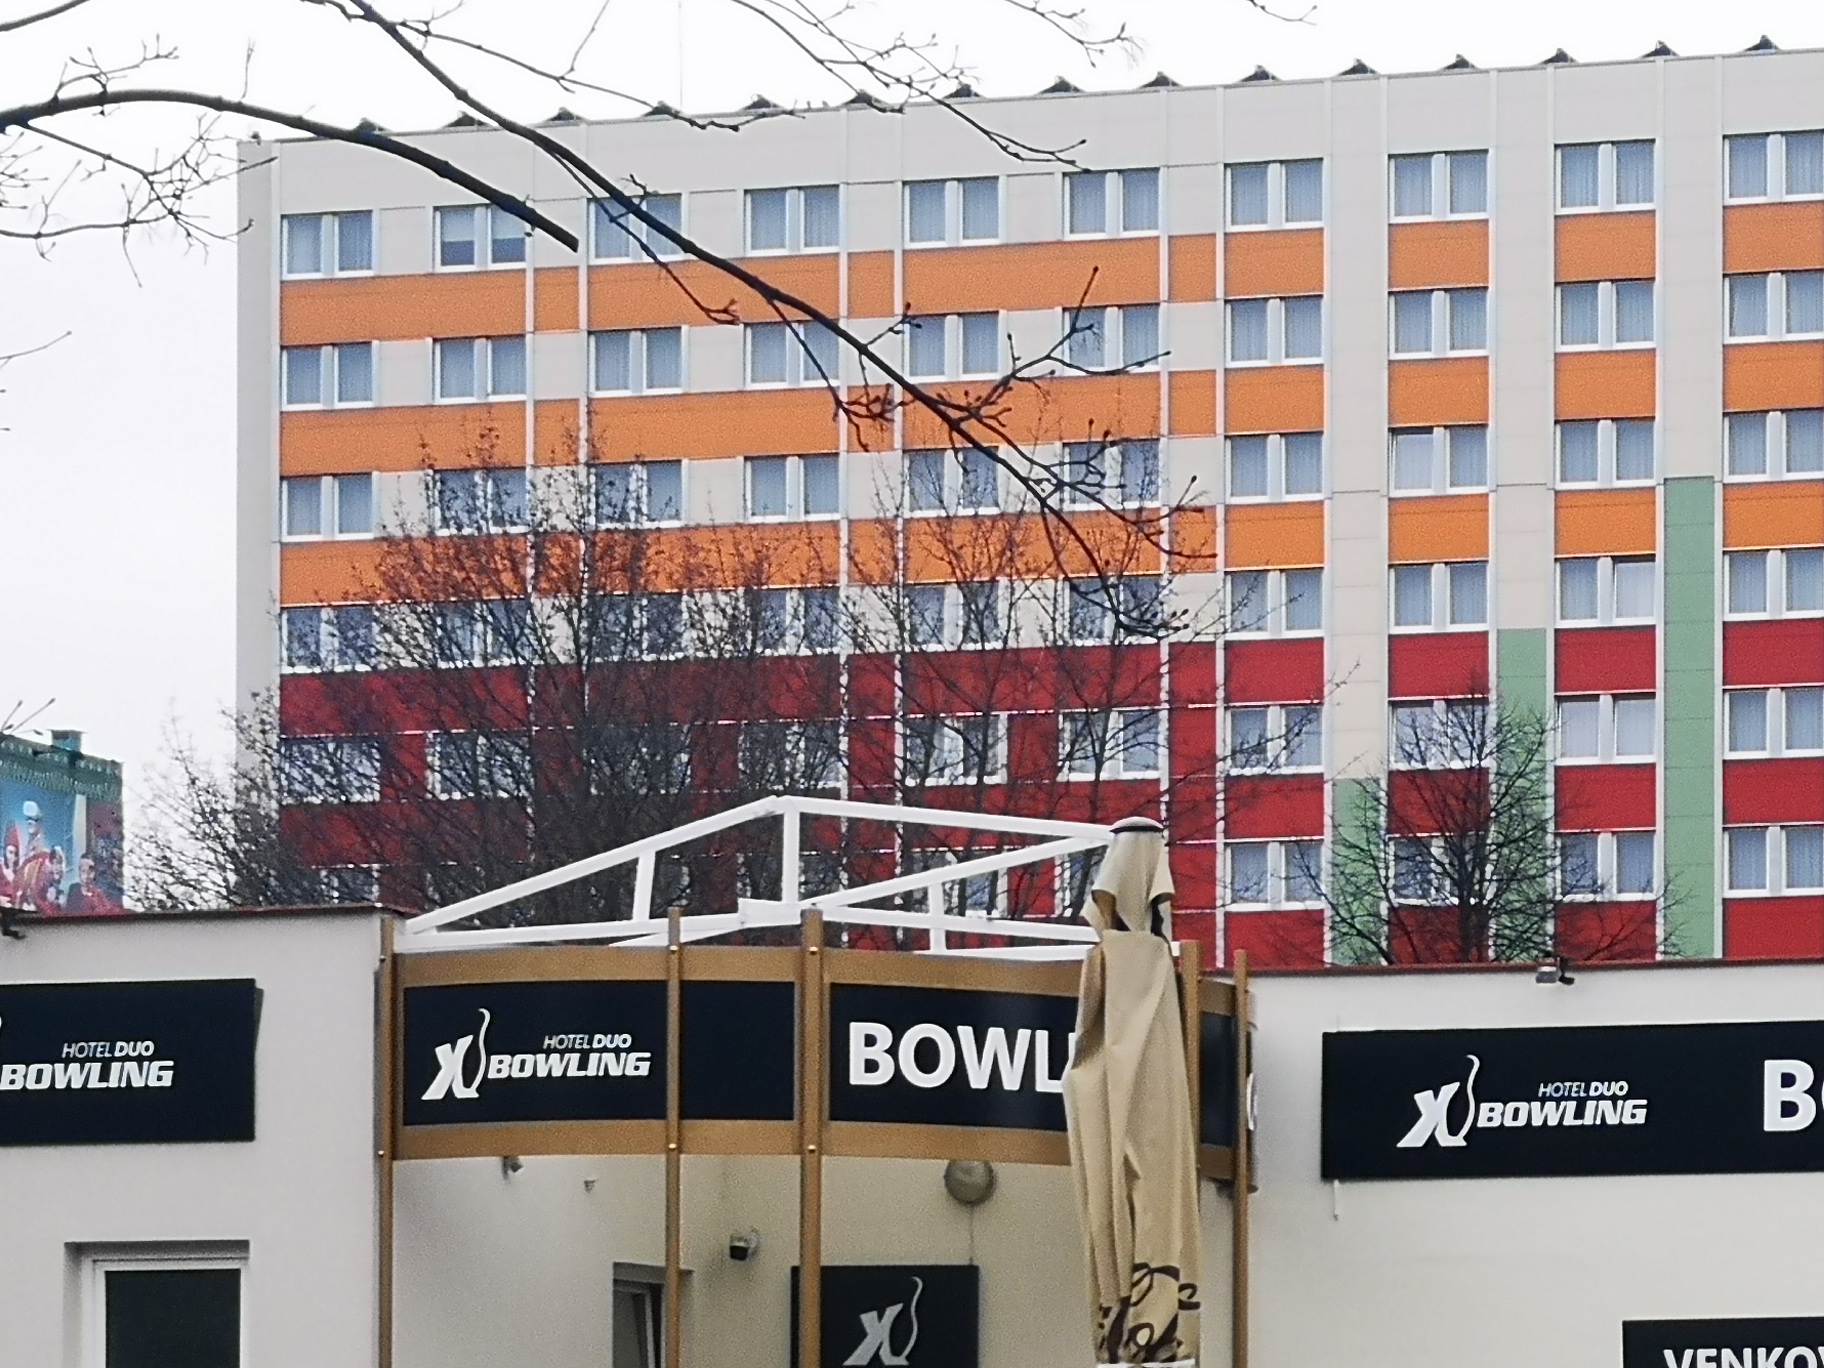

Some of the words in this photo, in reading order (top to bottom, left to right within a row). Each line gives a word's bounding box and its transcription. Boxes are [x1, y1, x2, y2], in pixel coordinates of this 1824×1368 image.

[61, 1041, 113, 1058] HOTEL
[114, 1040, 155, 1058] DUO
[543, 1034, 591, 1049] HOTEL
[592, 1033, 632, 1049] DUO
[0, 1060, 175, 1091] BOWLING
[487, 1052, 652, 1079] BOWLING
[1538, 1081, 1587, 1097] HOTEL
[1588, 1080, 1629, 1097] DUO
[1476, 1099, 1648, 1128] BOWLING
